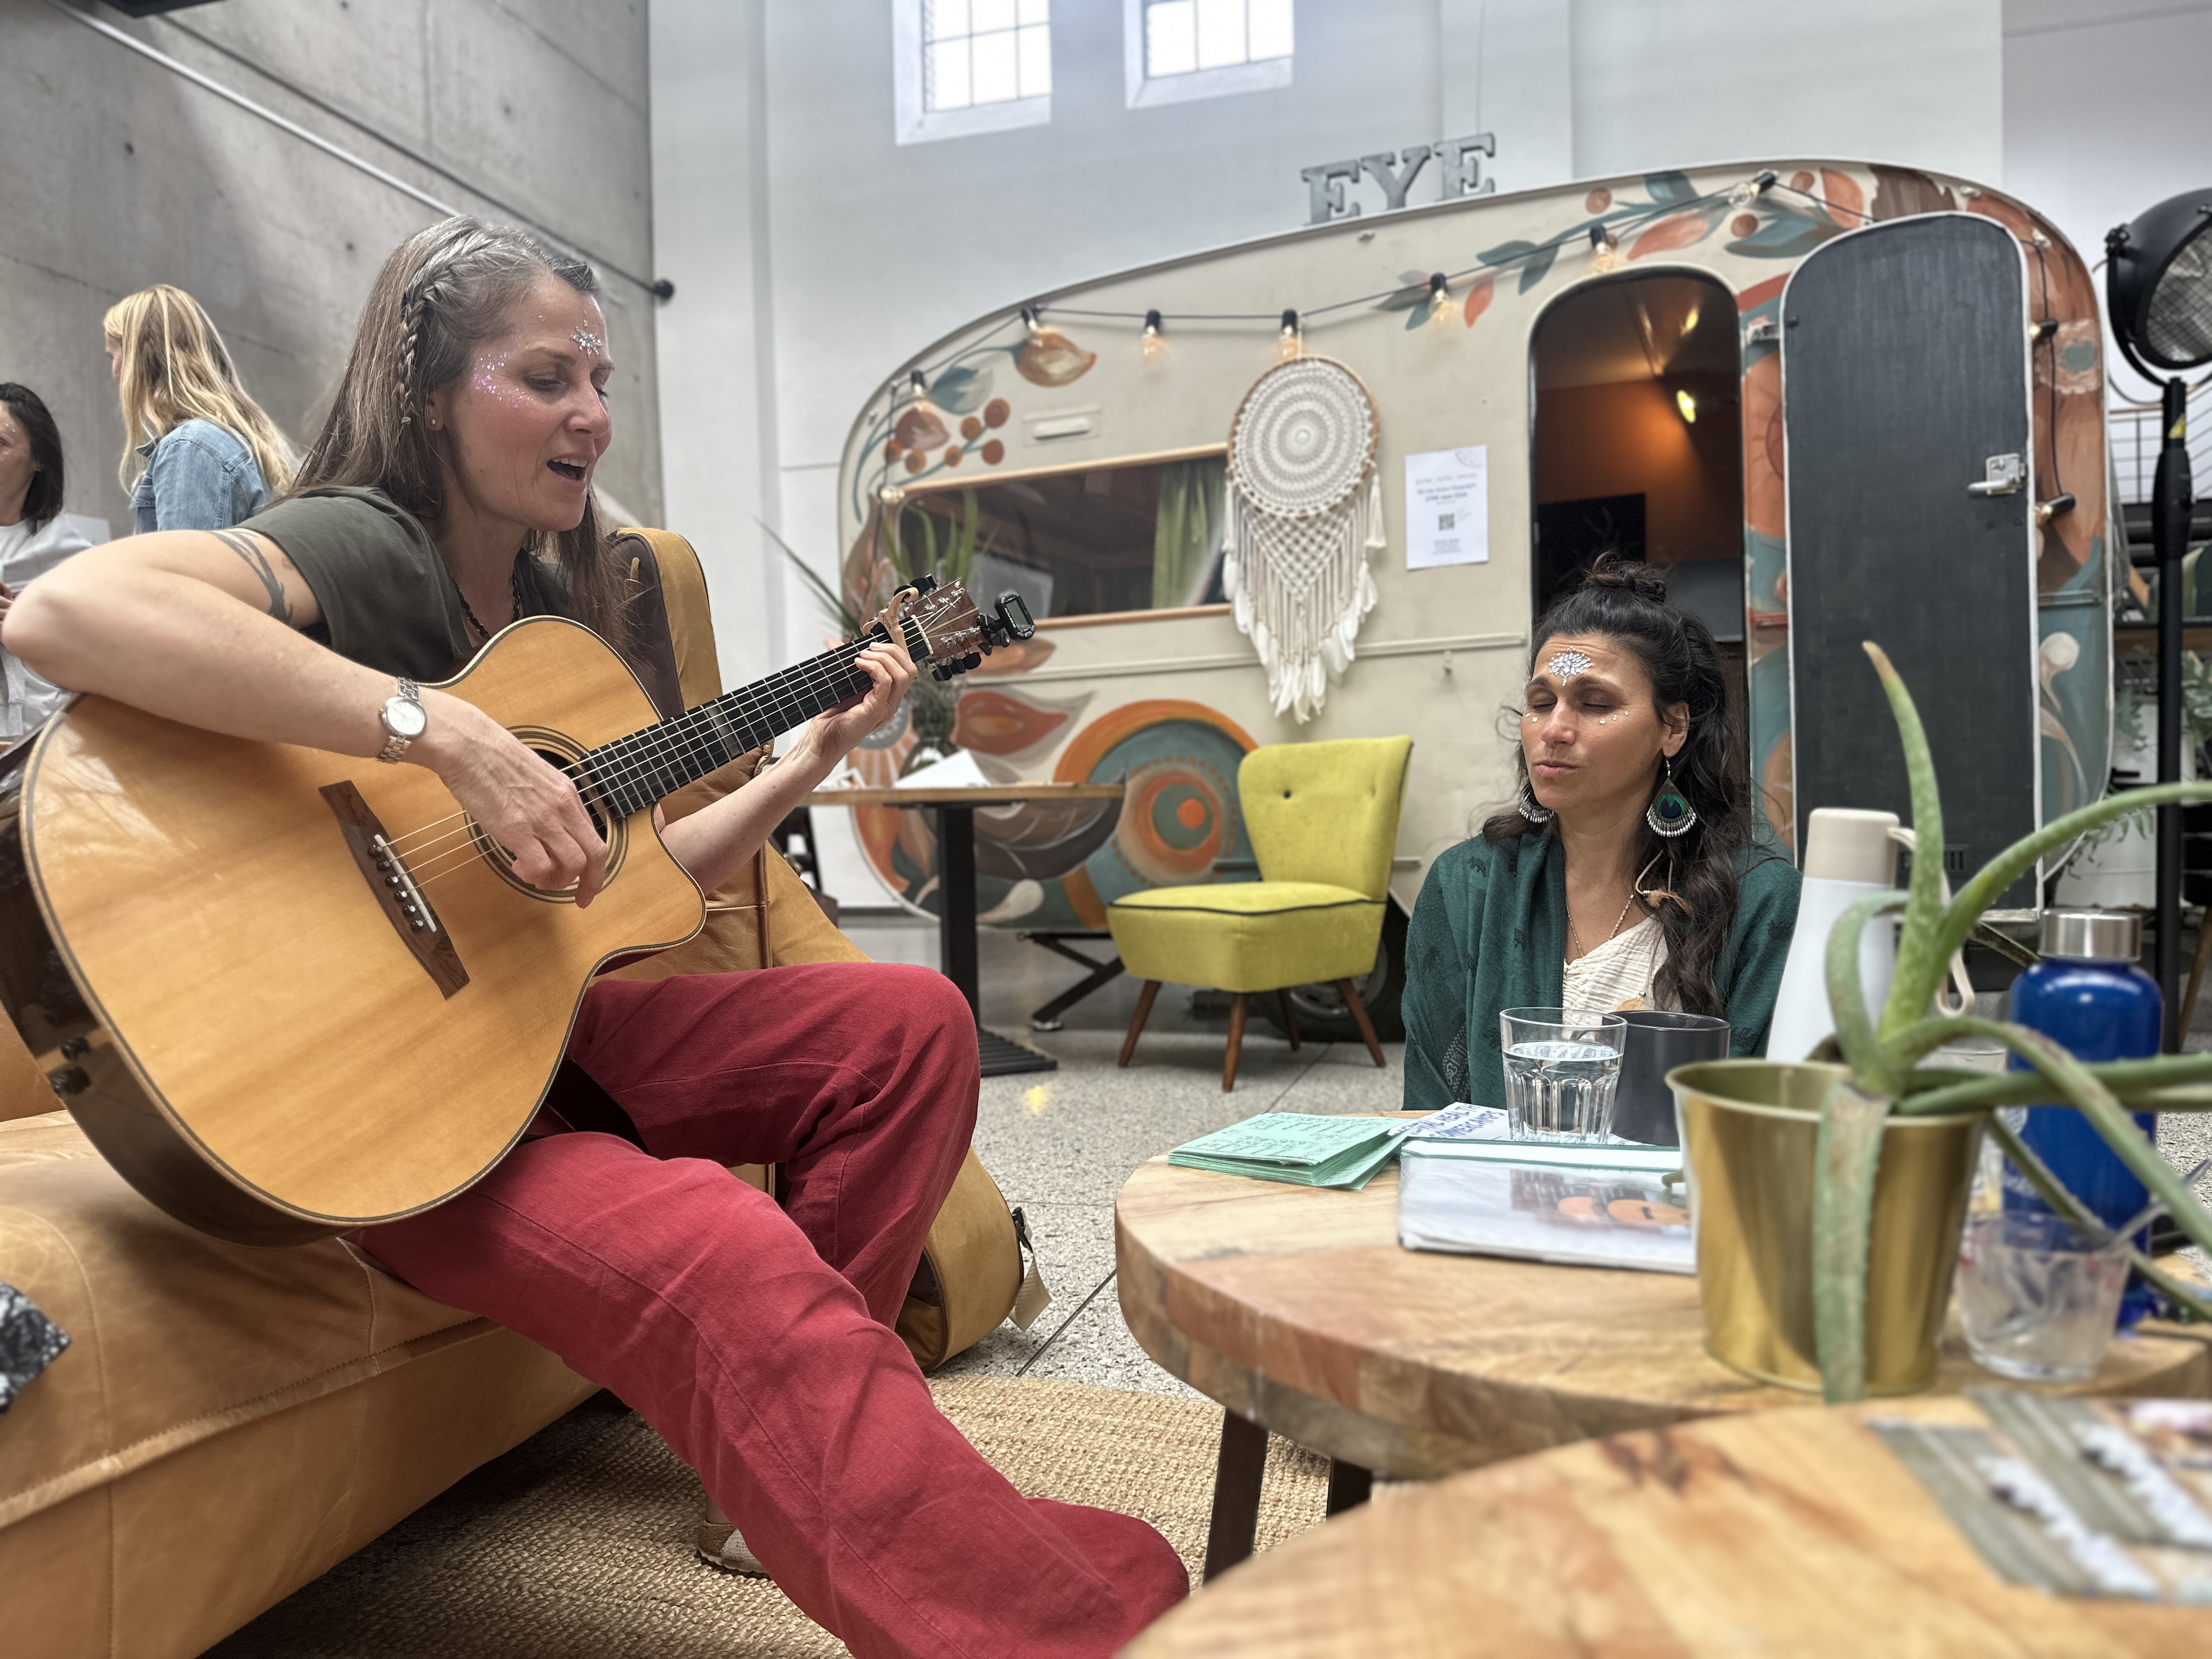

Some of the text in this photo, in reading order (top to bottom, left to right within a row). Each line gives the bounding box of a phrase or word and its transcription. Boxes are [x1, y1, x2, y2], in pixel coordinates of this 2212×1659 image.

[1300, 132, 1496, 227] EYE
[881, 614, 892, 630] KYSER
[1434, 1104, 1481, 1122] HEALTH
